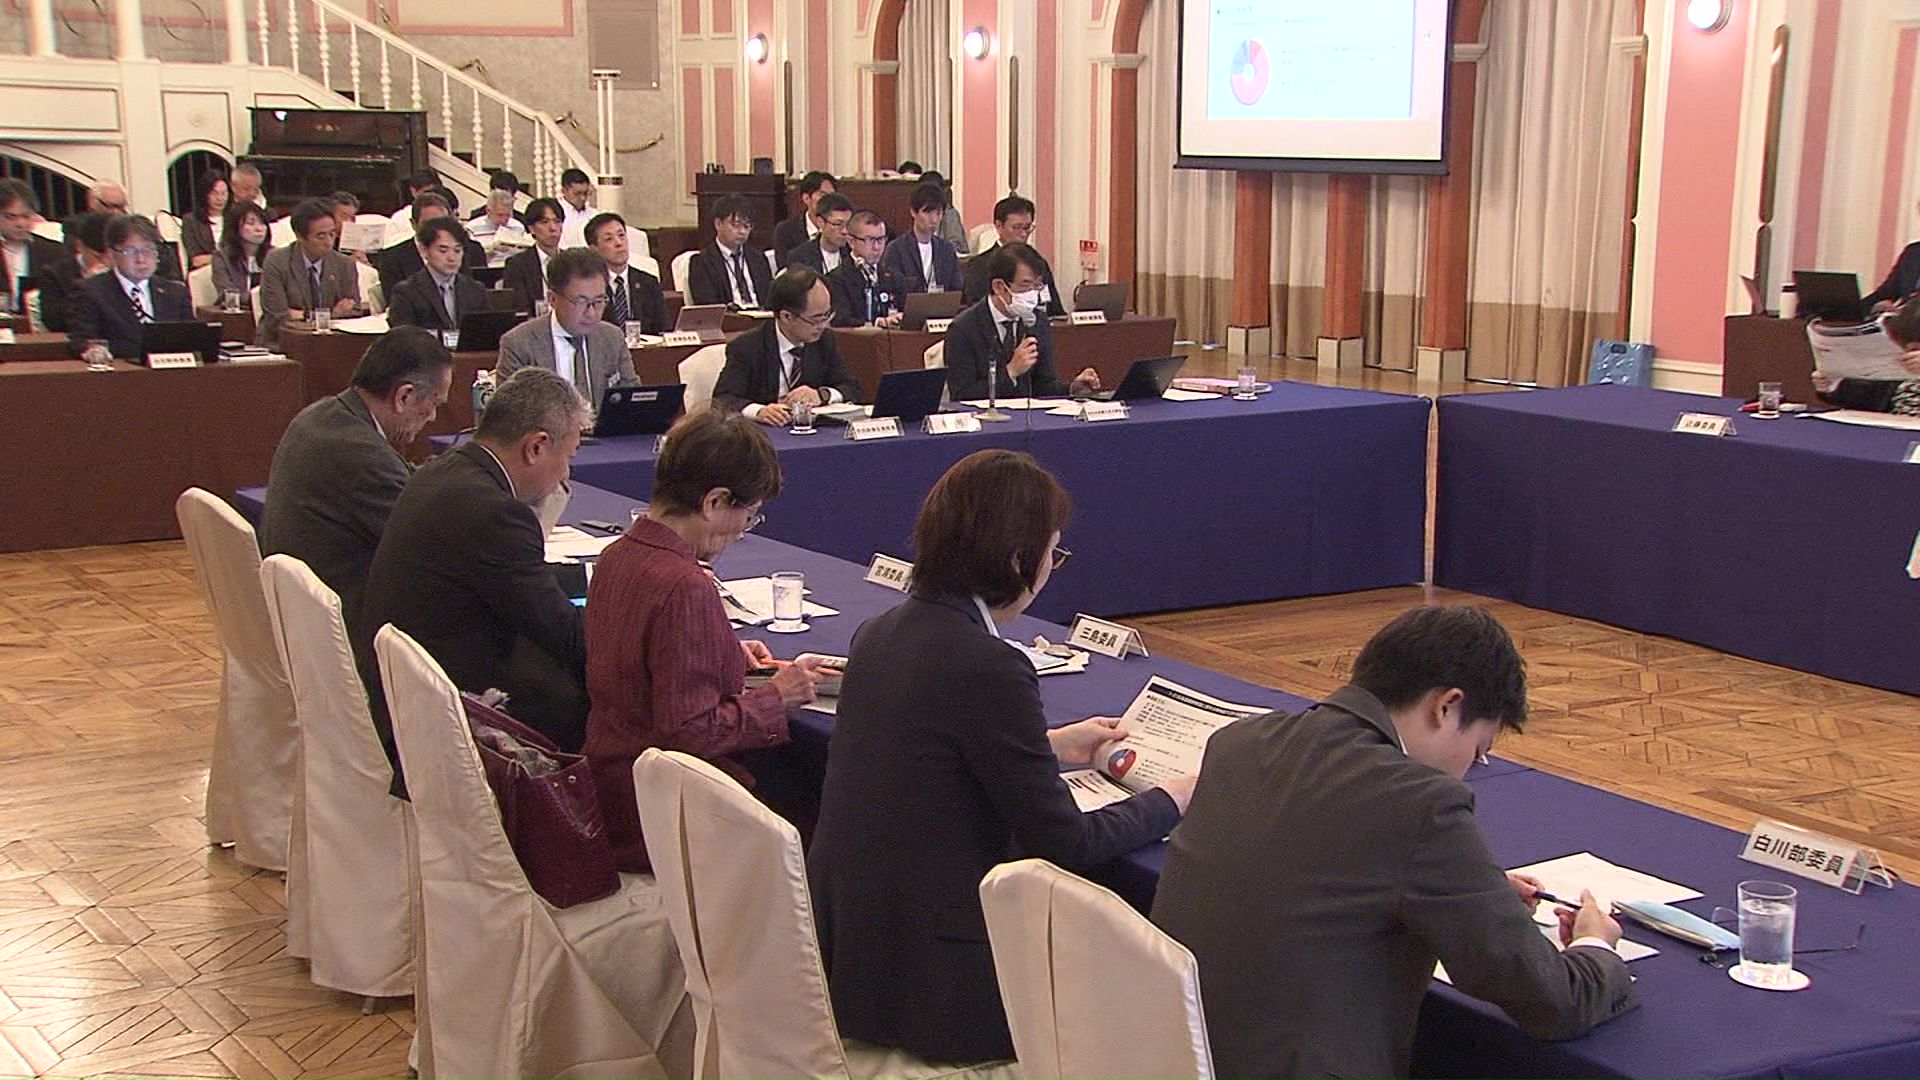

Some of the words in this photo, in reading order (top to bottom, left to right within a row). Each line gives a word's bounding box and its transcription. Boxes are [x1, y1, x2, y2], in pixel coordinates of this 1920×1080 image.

[1079, 626, 1118, 648] 三島委員
[1753, 833, 1845, 876] 白川部委員
